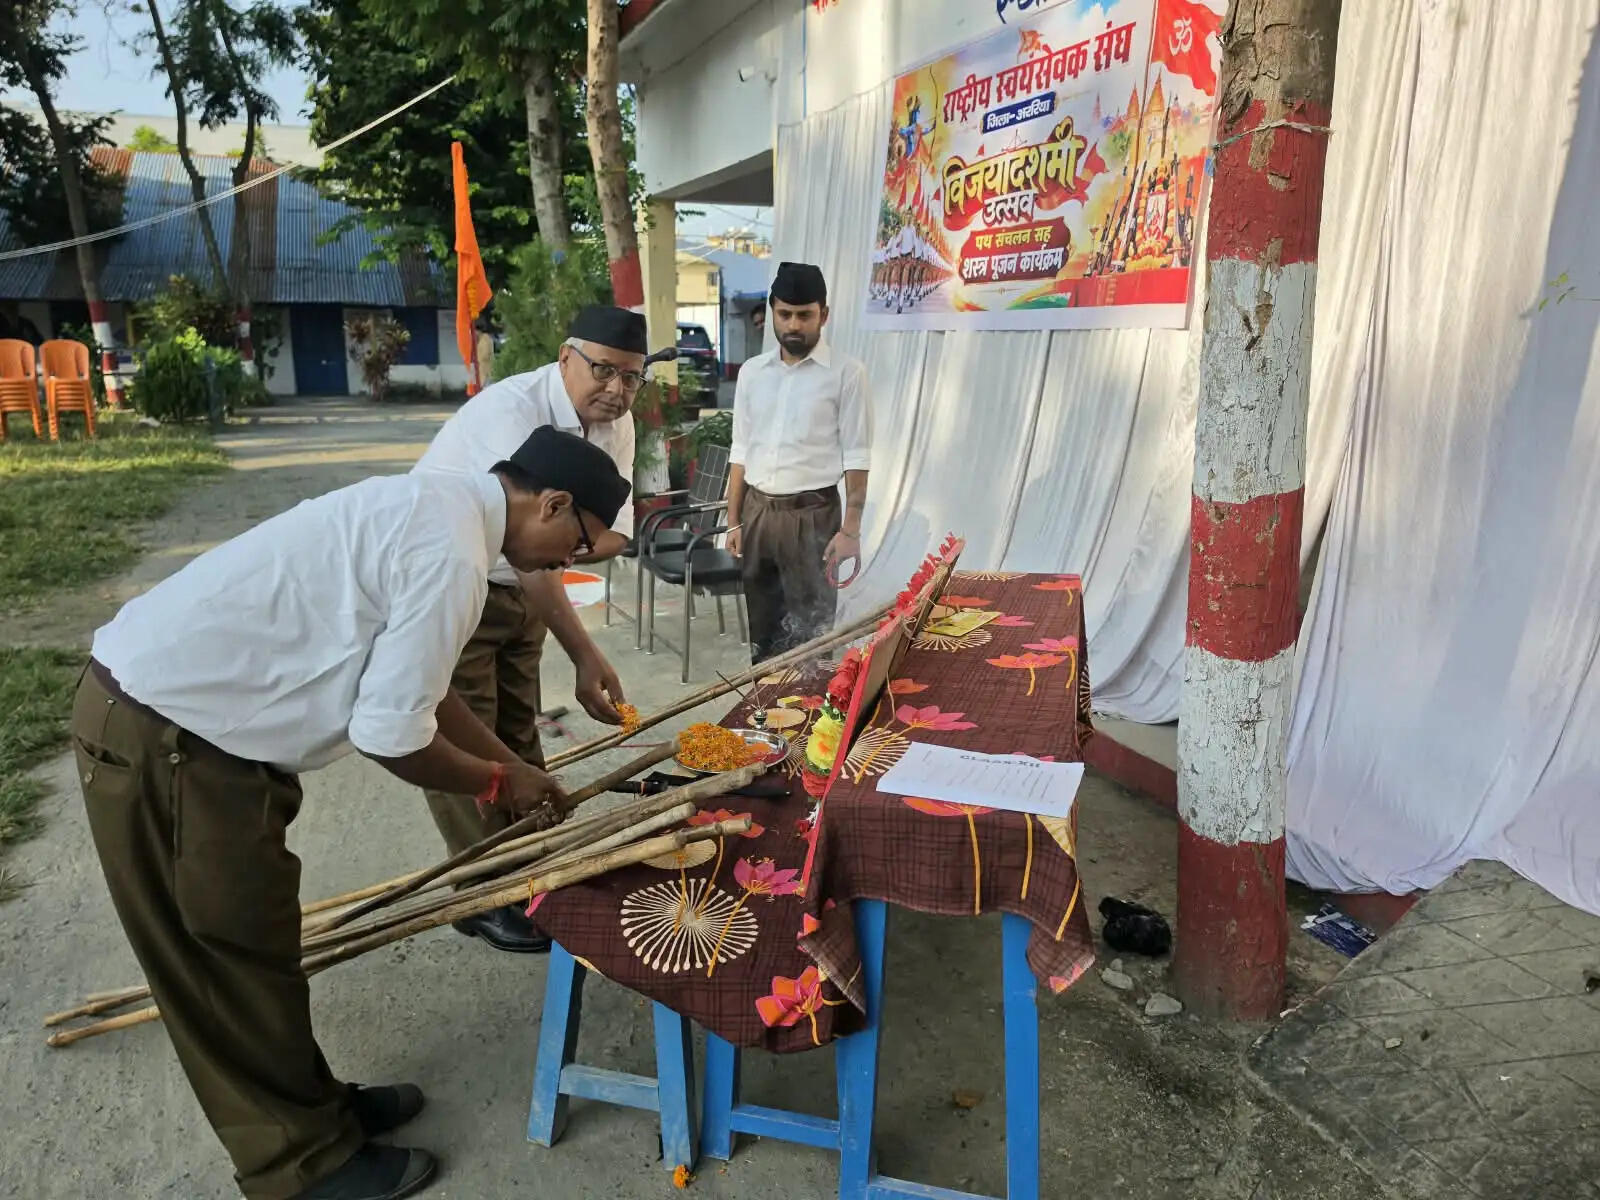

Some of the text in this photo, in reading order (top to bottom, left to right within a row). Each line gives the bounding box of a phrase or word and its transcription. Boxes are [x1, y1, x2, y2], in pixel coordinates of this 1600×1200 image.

[943, 21, 1136, 123] राष्ट्रीय स्वयंसेवक संघ
[943, 116, 1083, 215] विजयादशमी
[983, 190, 1038, 224] उत्सव
[975, 225, 1053, 250] पथ संचलन सह
[962, 243, 1064, 280] शस्त्र पूजन कार्यक्रम
